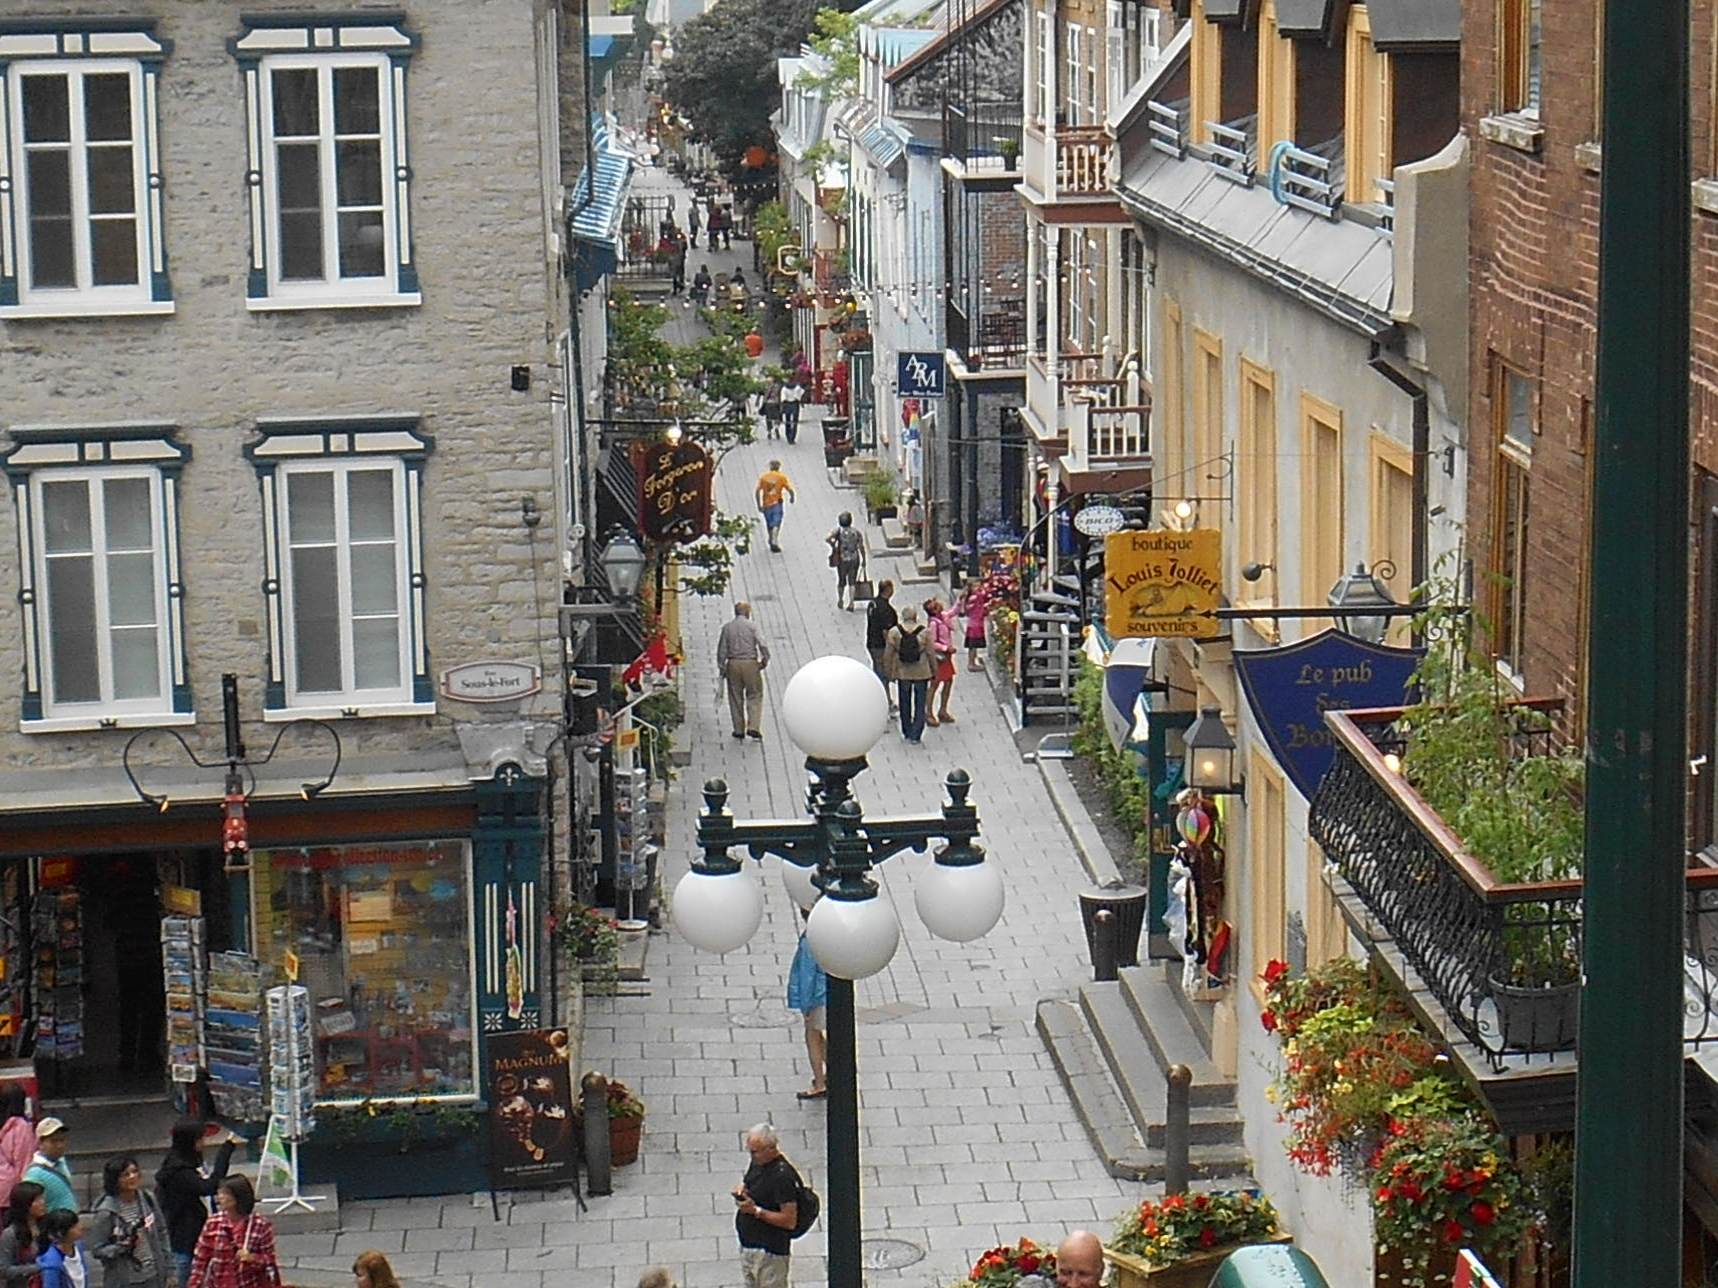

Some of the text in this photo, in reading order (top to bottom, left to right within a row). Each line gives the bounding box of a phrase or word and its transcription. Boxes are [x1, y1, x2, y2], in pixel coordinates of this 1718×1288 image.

[1085, 517, 1114, 525] BICO
[1132, 536, 1193, 554] boutique
[1108, 557, 1219, 596] Louis Jolliet
[1127, 618, 1198, 632] souvenirs
[1295, 660, 1372, 685] Le pub
[461, 677, 520, 688] Sous-le-Fort
[495, 1054, 563, 1070] MAGNUM
